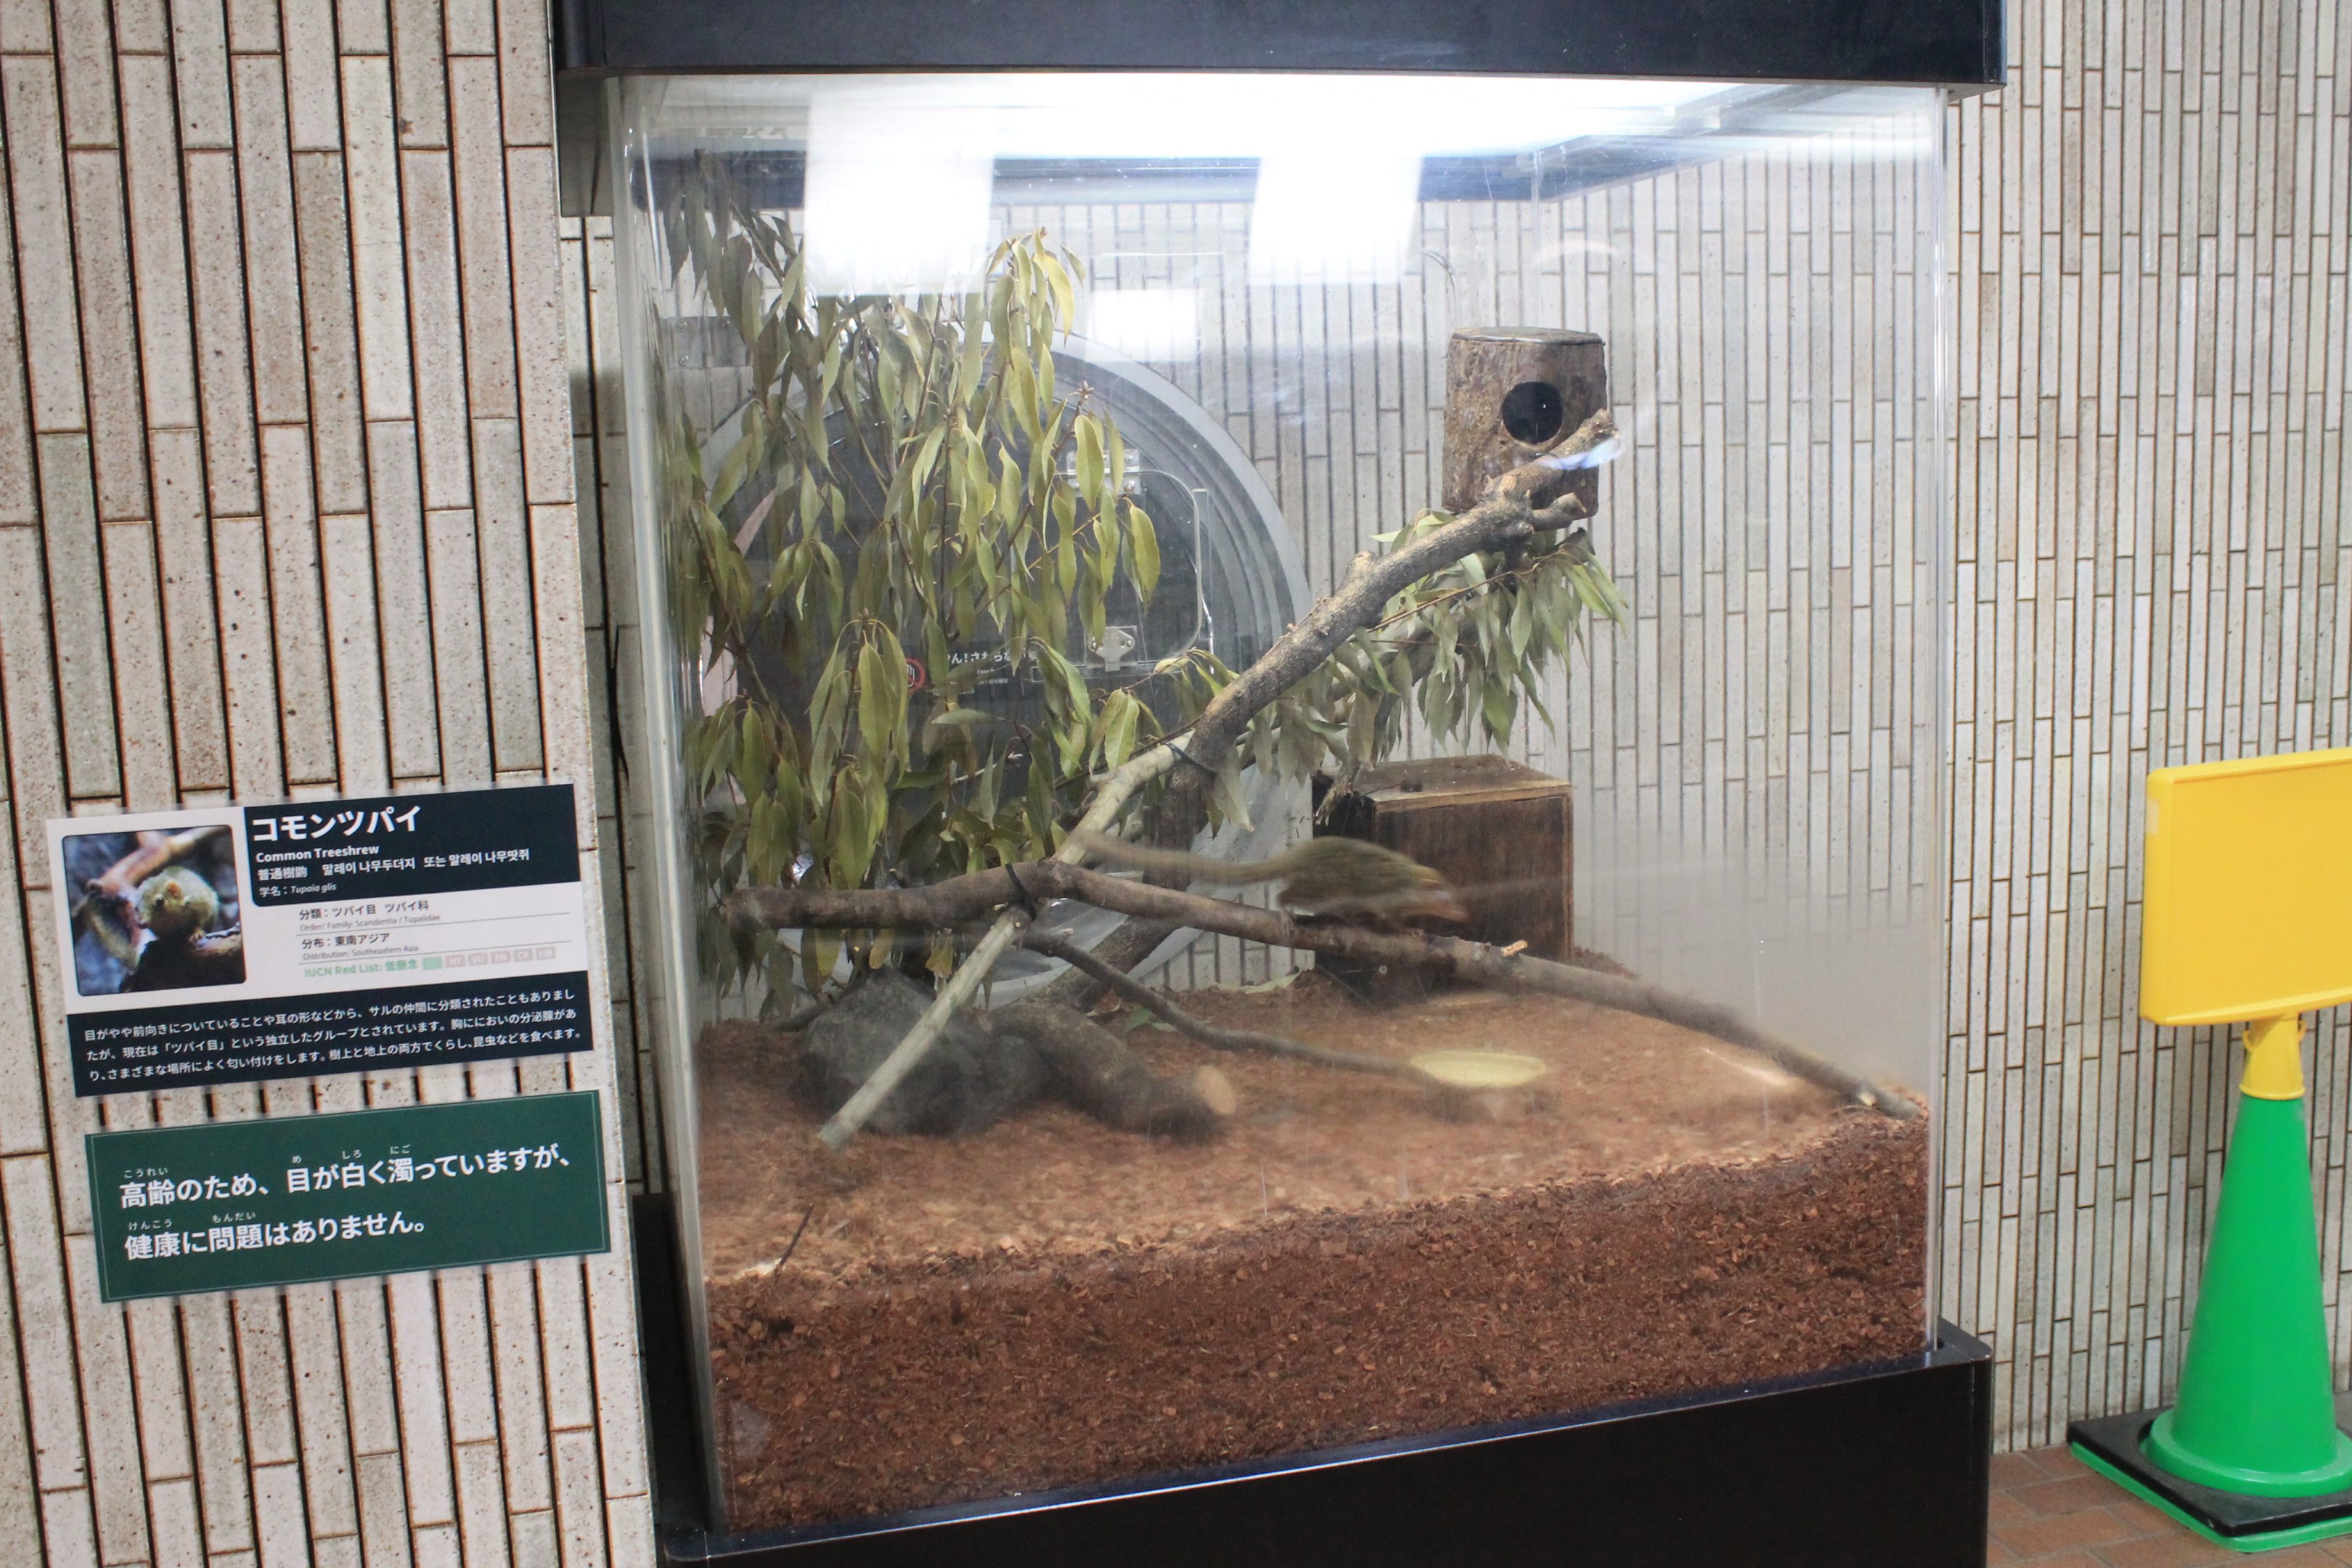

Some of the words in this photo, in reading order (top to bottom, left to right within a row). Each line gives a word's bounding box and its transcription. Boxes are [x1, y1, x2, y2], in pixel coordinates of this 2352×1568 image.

[252, 804, 422, 843] コモンツパイ
[256, 849, 311, 862] Common
[314, 844, 380, 858] Treeshrew
[322, 861, 356, 875] 말레이
[359, 857, 415, 873] 나무두더지
[423, 854, 446, 867] 또는
[449, 852, 482, 866] 말레이
[484, 848, 530, 863] 나무땃쥐
[321, 882, 336, 892] glis
[301, 932, 390, 949] 分布：東南アジア
[351, 946, 401, 956] Southeastern
[304, 966, 332, 977] IUCN
[334, 964, 356, 975] Red
[359, 963, 382, 973] List:
[123, 1166, 169, 1178] こうれい
[291, 1155, 302, 1164] め
[342, 1148, 362, 1160] しろ
[389, 1144, 412, 1155] にご
[119, 1143, 571, 1209] 高齢のため、目が白く濁っていますが、
[128, 1218, 173, 1231] けんこう
[211, 1211, 256, 1224] もんだい
[124, 1209, 425, 1261] 健康に問題はありません。
